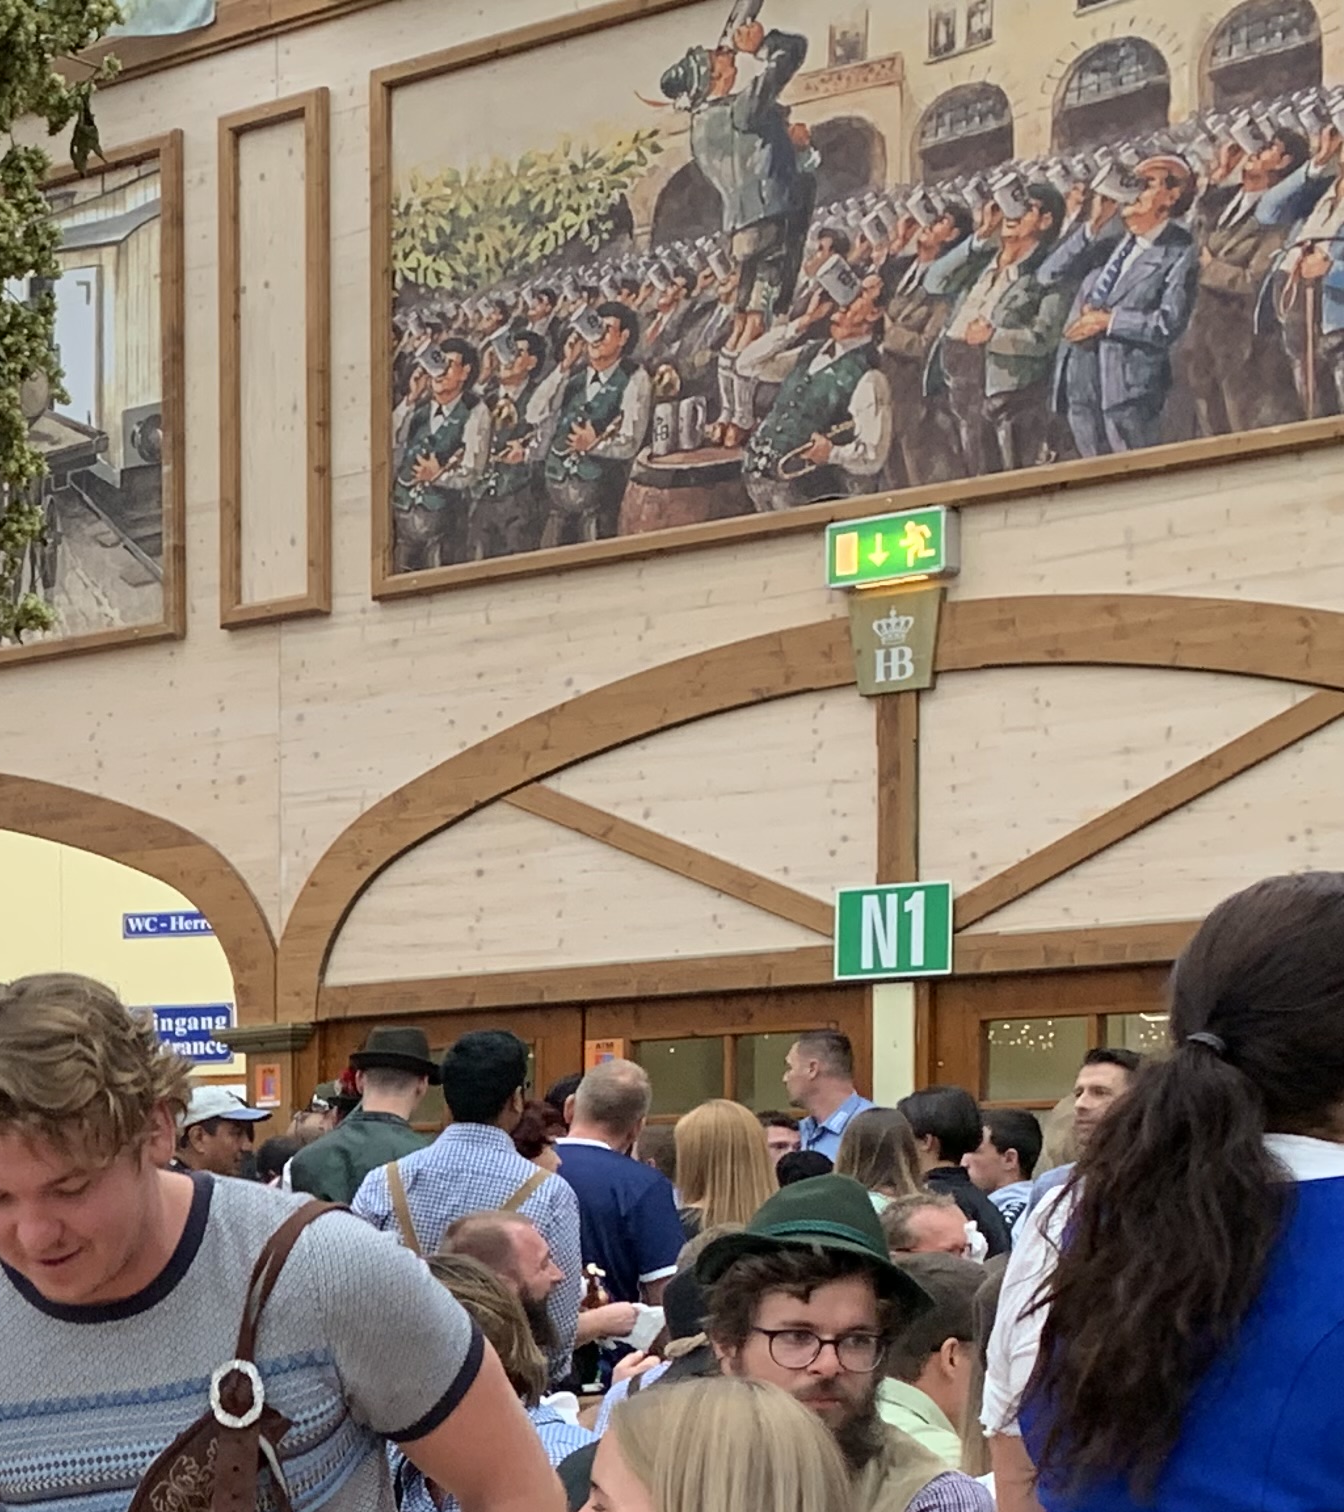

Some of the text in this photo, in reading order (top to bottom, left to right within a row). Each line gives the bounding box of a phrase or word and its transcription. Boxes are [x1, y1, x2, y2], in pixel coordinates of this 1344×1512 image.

[874, 646, 915, 683] HB
[128, 917, 158, 932] WC
[170, 916, 212, 931] Herr
[861, 891, 925, 969] N1
[153, 1012, 227, 1037] ingang
[163, 1039, 228, 1055] rance
